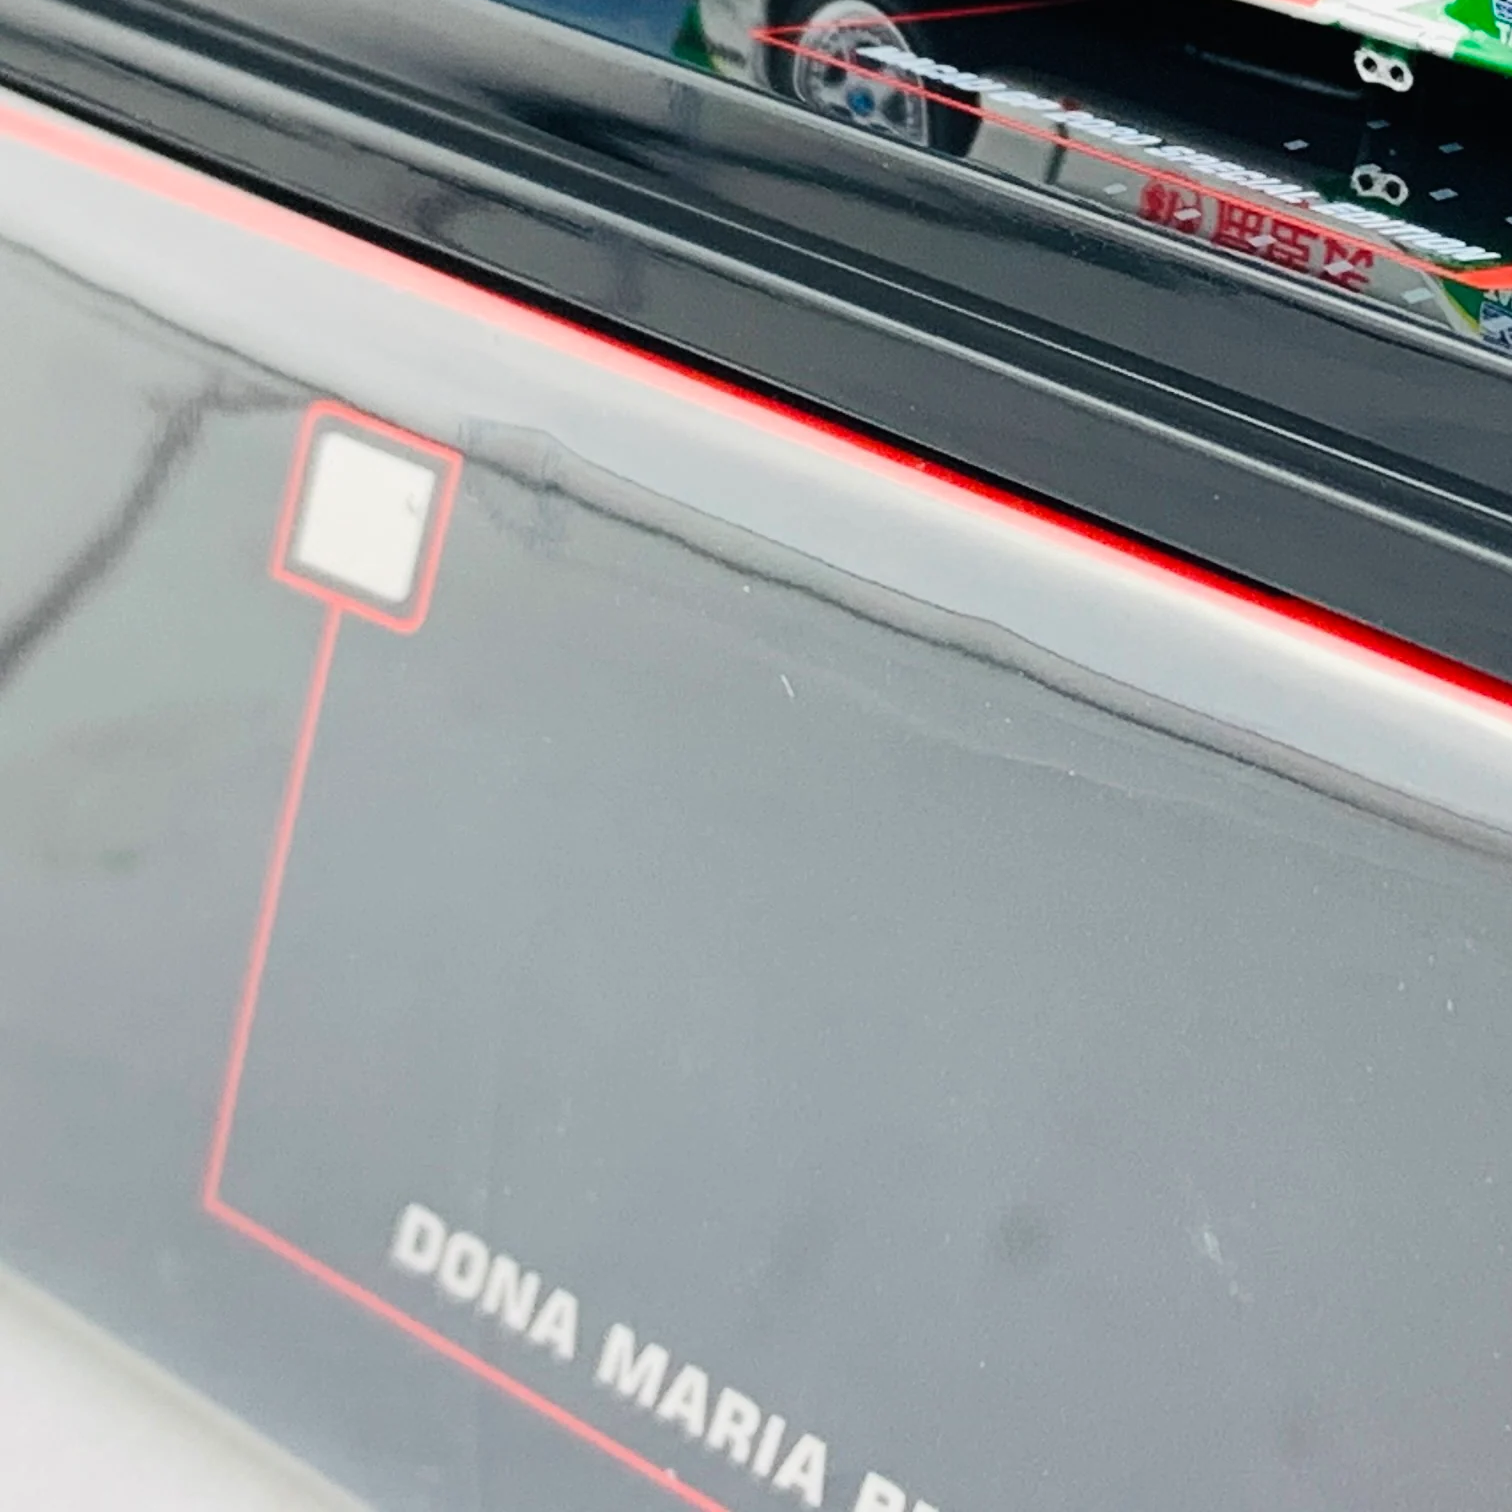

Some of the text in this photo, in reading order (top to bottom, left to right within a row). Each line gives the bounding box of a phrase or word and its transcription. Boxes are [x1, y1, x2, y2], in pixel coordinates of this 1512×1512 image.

[1142, 144, 1322, 205] SPECIAL
[1305, 200, 1502, 262] EDITION
[394, 1202, 829, 1509] DONA MARIA
